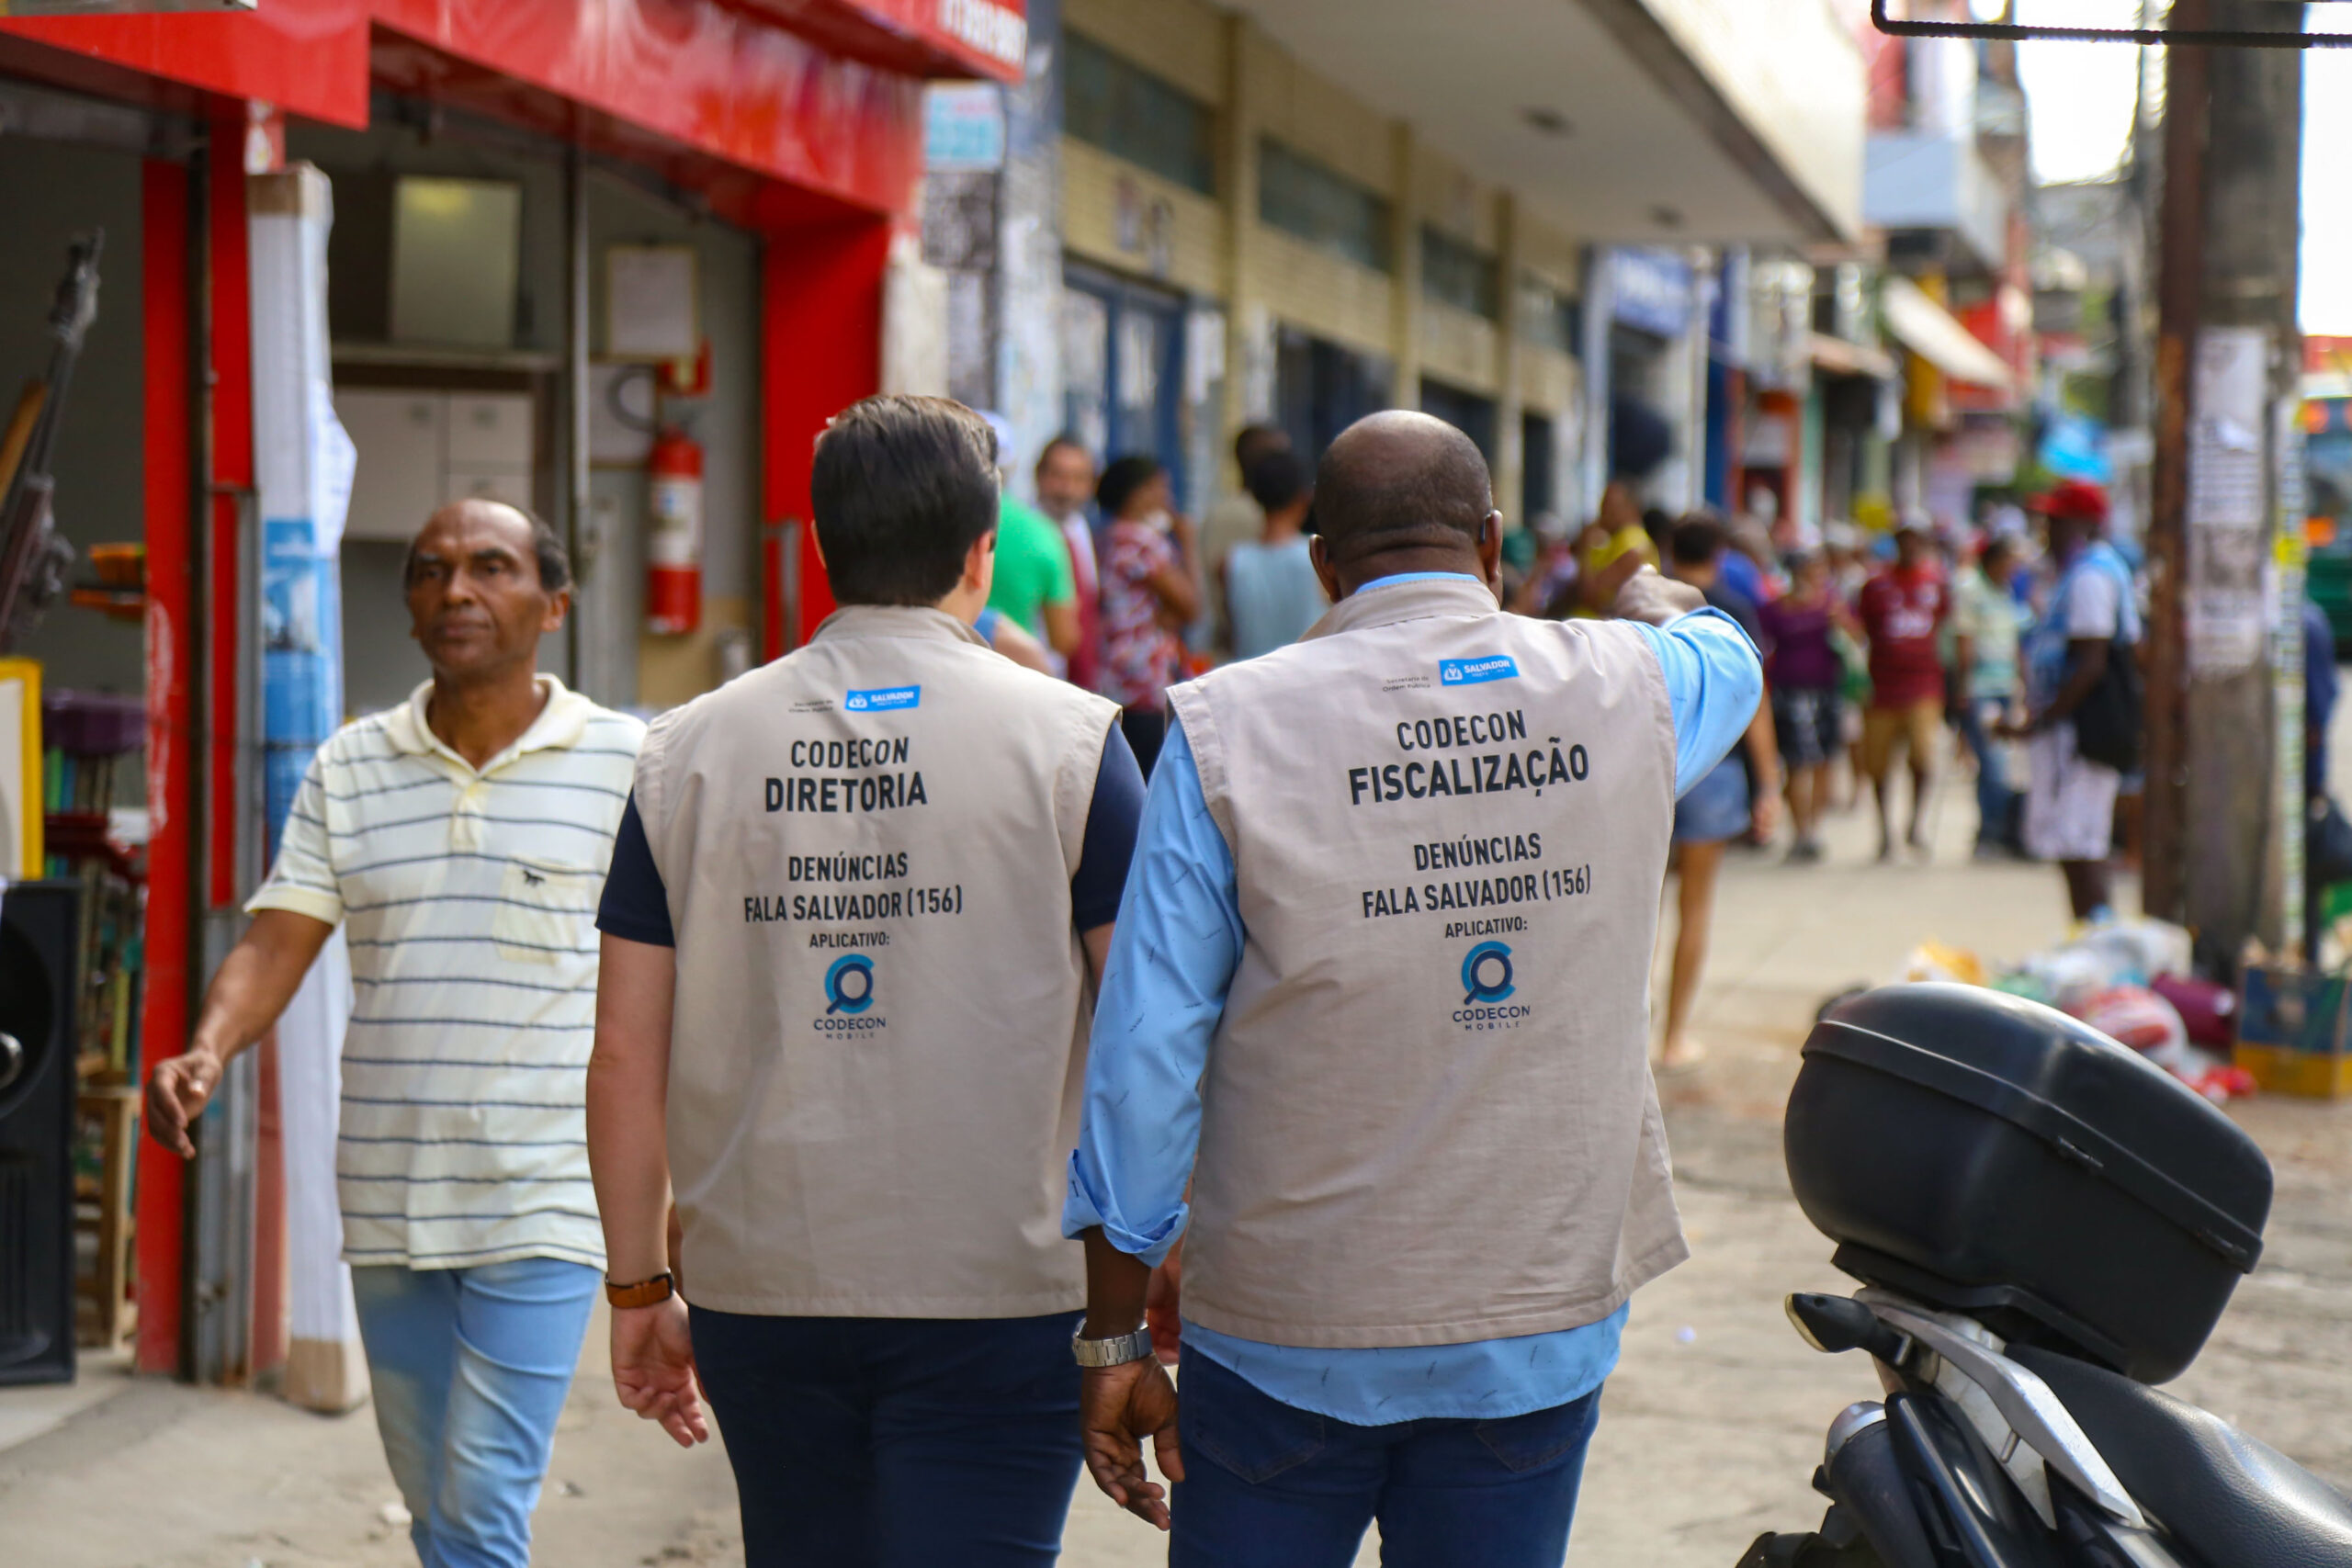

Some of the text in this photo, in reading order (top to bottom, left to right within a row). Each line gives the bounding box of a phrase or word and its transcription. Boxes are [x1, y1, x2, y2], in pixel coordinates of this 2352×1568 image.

[1463, 660, 1511, 674] SALVADOR
[1396, 709, 1528, 751] CODECON
[791, 737, 910, 770] CODECON
[1348, 737, 1590, 806] FISCALIZAÇÃO
[765, 771, 928, 813] DIRETORIA
[788, 851, 909, 882] DENÚNCIAS
[1413, 832, 1543, 871] DENÚNCIAS
[743, 885, 964, 922] FALA SALVADOR (156)
[1362, 863, 1592, 919] FALA SALVADOR (156)
[808, 931, 890, 949] APLICATIVO:
[1444, 916, 1529, 939] APLICATIVO:
[813, 1017, 888, 1031] CODECON
[1453, 1005, 1532, 1022] CODECON
[1464, 1021, 1521, 1031] MOBILE
[825, 1032, 876, 1040] MOBILE
